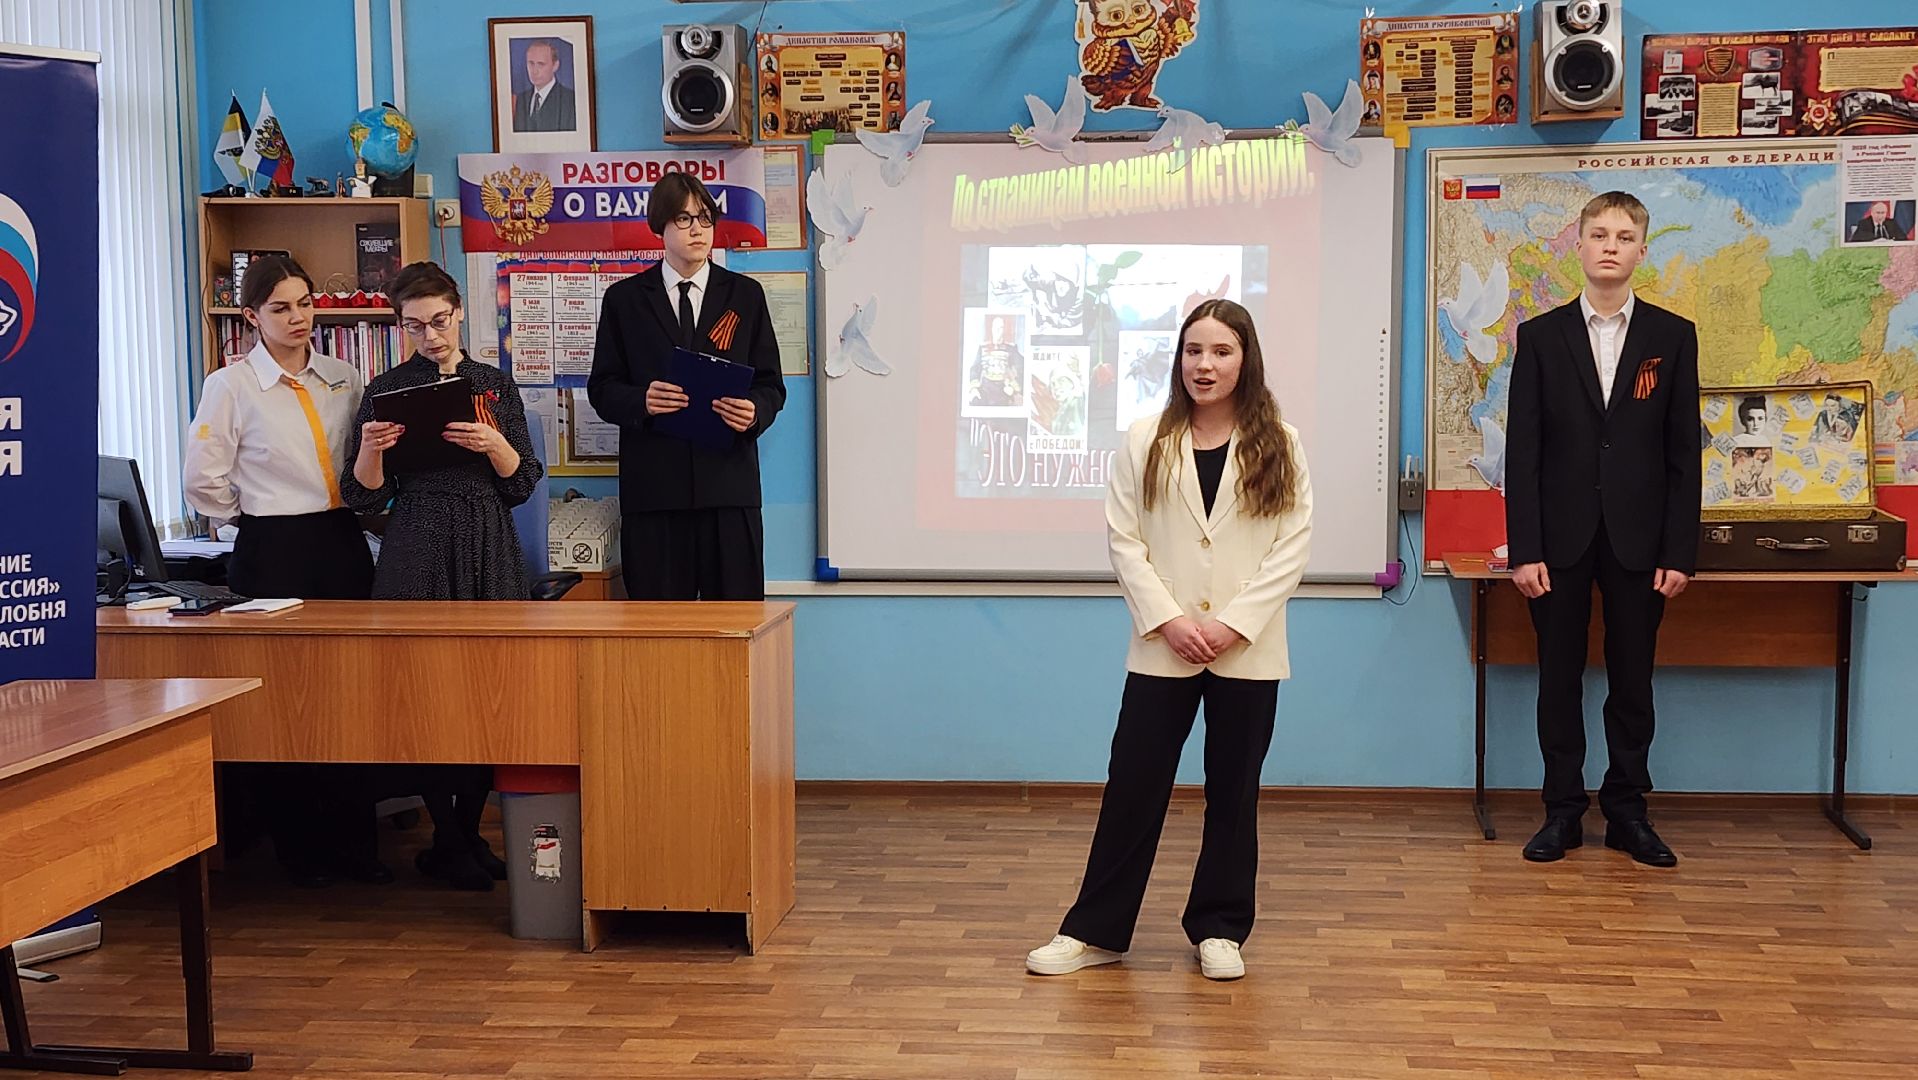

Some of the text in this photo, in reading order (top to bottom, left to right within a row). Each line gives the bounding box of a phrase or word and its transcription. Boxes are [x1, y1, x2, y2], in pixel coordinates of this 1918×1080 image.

[1386, 22, 1429, 31] ДИНАСТИЯ
[786, 36, 876, 46] ДИНАСТИЯ РОМАНОВЫХ
[1578, 151, 1836, 169] РОССИЙСКАЯ ФЕДЕРАЦИ
[562, 159, 725, 185] РАЗГОВОРЫ
[951, 174, 979, 232] По
[976, 164, 1086, 234] страницам
[1088, 137, 1187, 218] военной
[563, 190, 728, 218] О ВАЖМ
[517, 274, 526, 282] 27
[516, 363, 526, 371] 24
